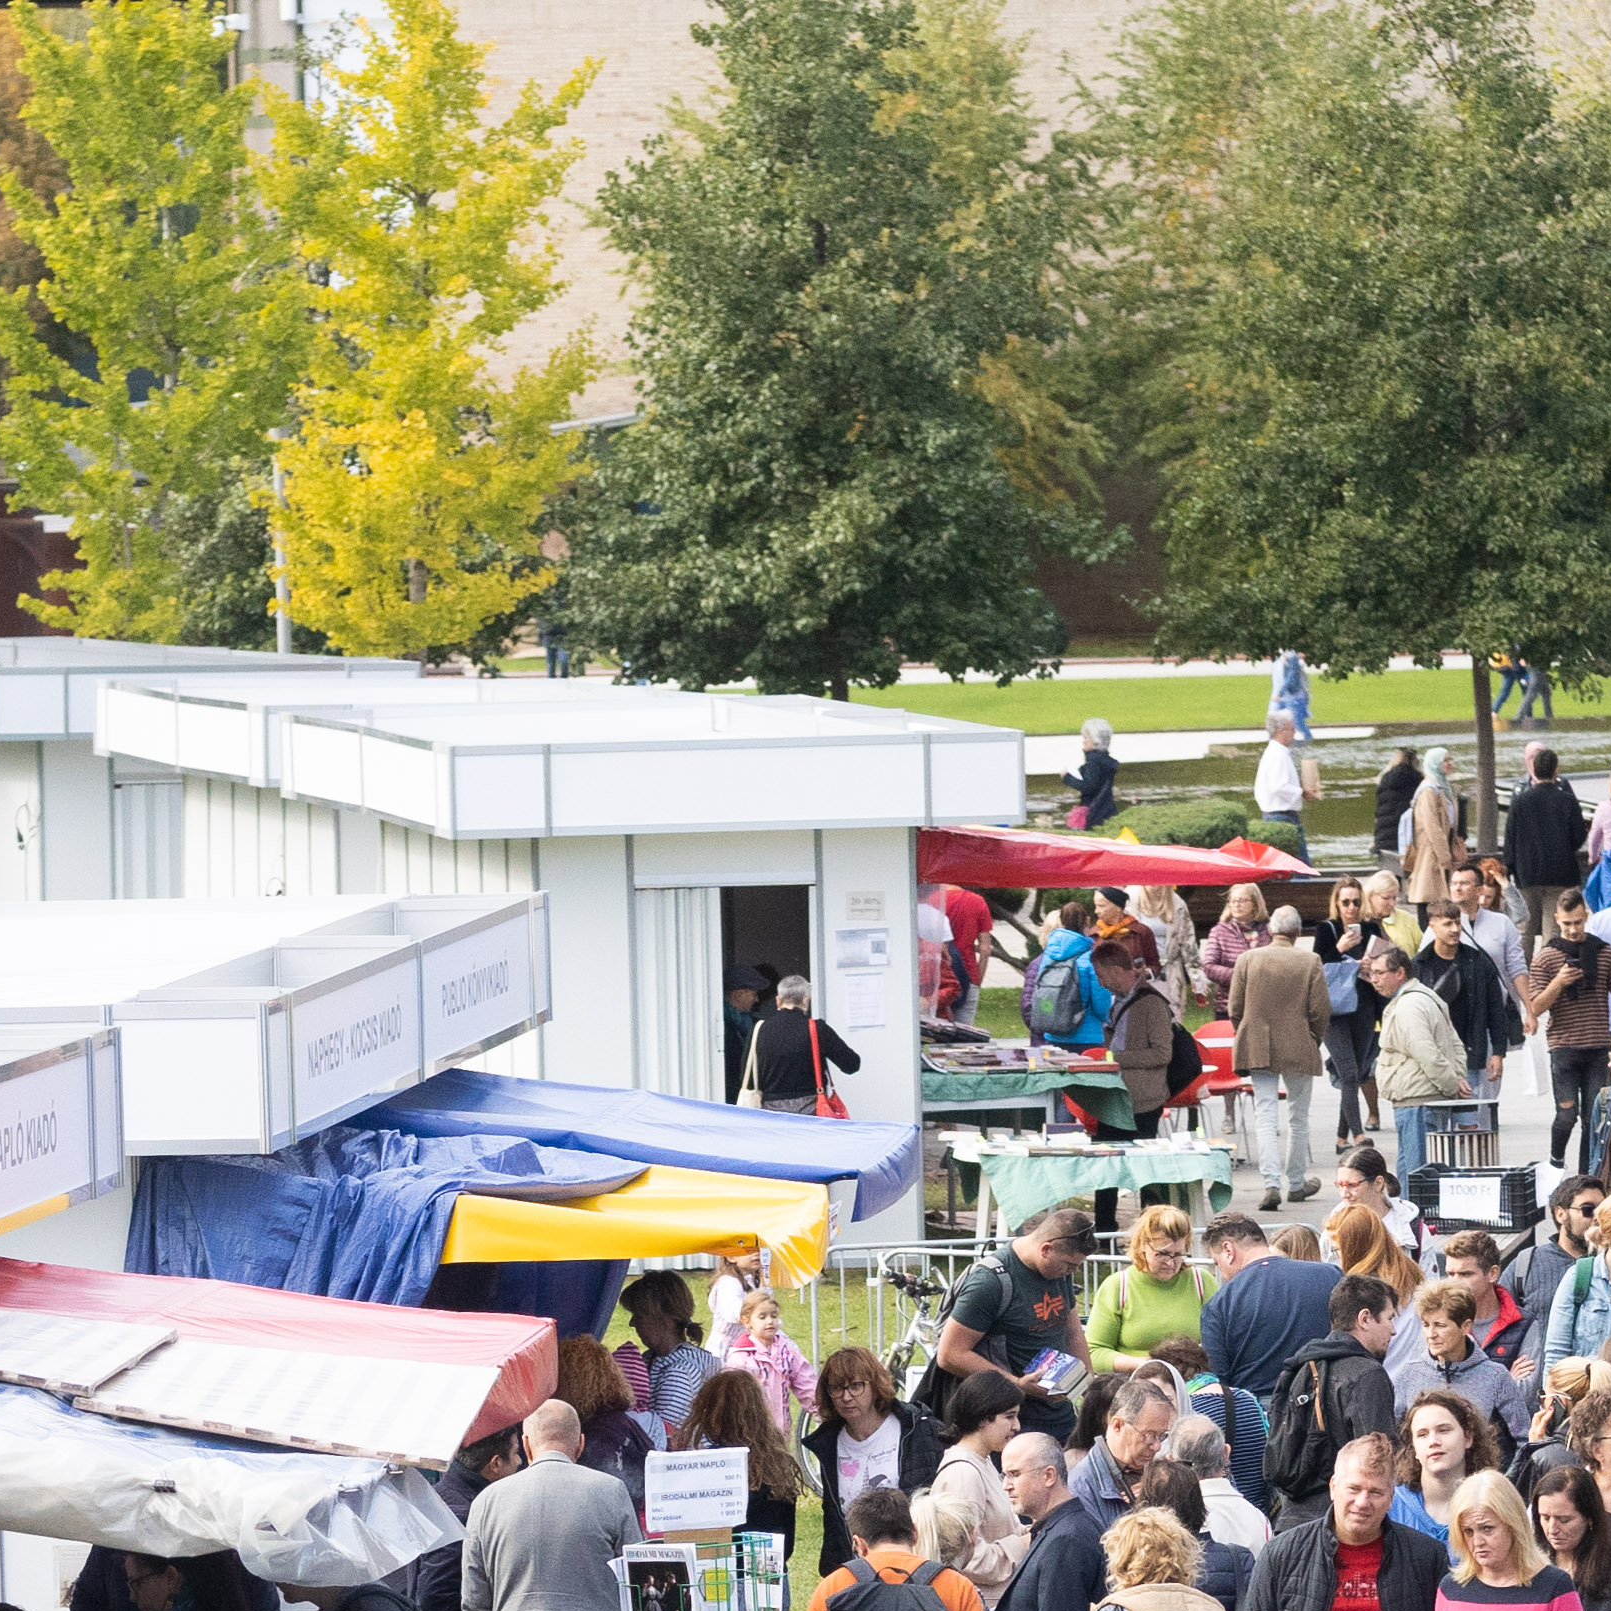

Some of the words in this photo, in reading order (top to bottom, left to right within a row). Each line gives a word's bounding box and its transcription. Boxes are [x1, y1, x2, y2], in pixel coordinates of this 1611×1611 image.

[307, 1027, 344, 1080] NAPHEGY
[350, 1014, 379, 1061] KOCSIS
[378, 993, 402, 1048] KIADÓ
[26, 1098, 57, 1162] KIADÓ
[1450, 1184, 1477, 1196] 1000
[666, 1463, 699, 1472] MAGYAR
[700, 1459, 726, 1469] NAPLÓ
[661, 1491, 698, 1501] IRODALMI
[699, 1489, 733, 1499] MAGAZIN
[626, 1550, 657, 1559] IRODALMI
[657, 1550, 686, 1559] MAGAZIN
